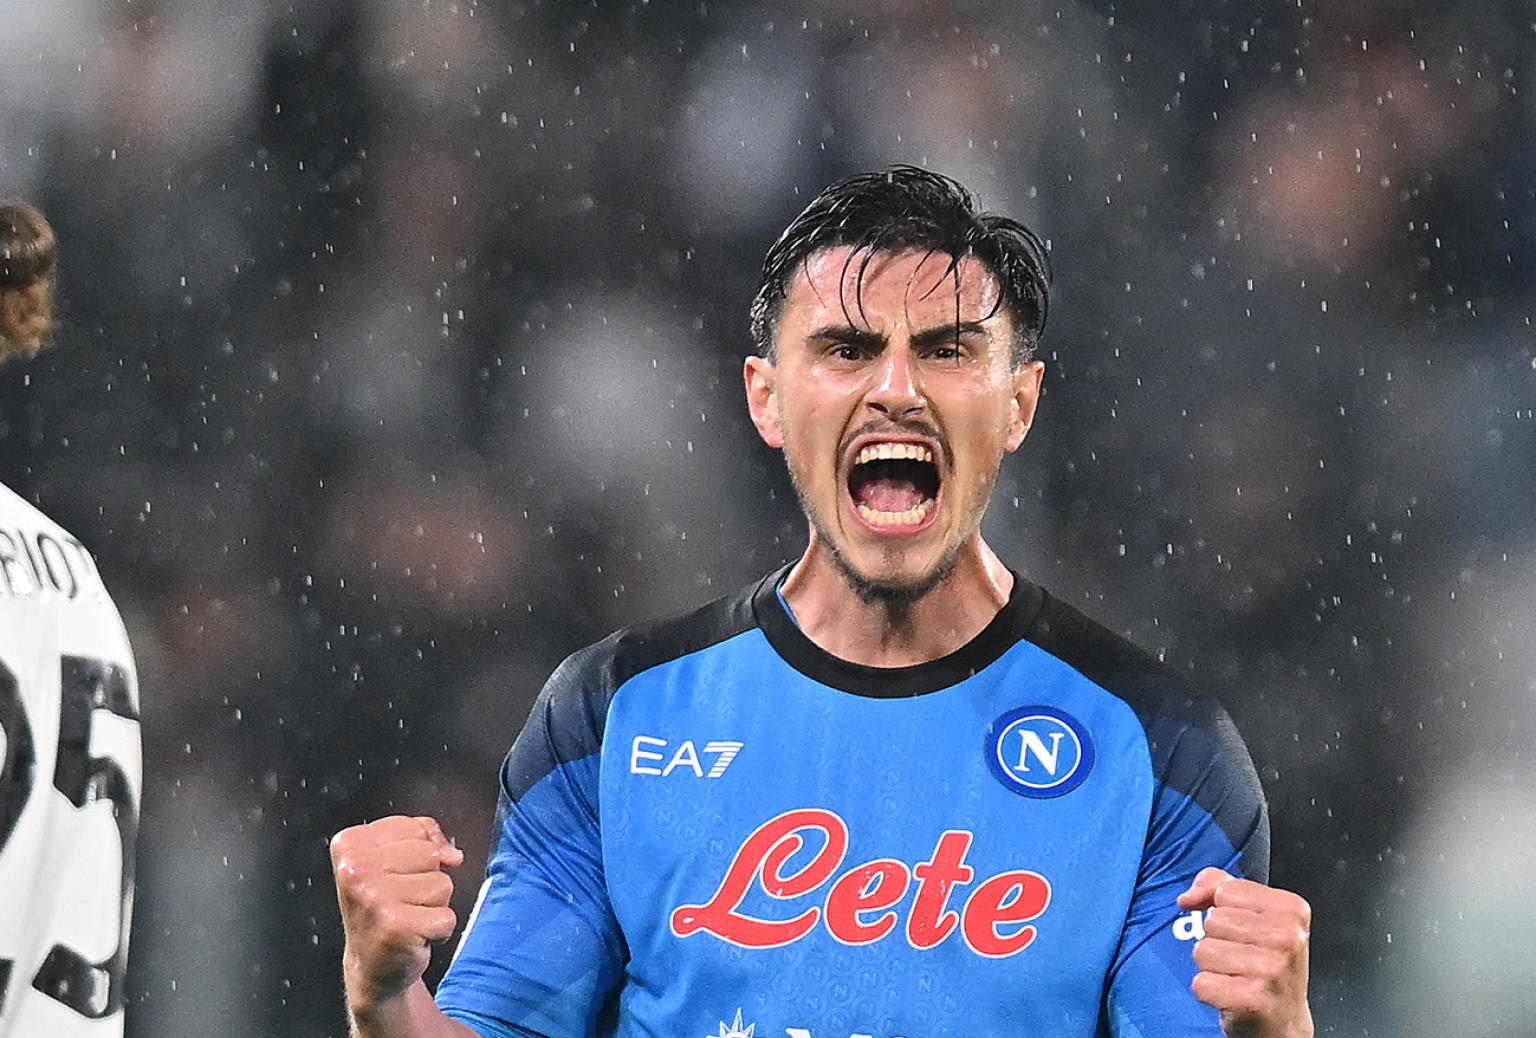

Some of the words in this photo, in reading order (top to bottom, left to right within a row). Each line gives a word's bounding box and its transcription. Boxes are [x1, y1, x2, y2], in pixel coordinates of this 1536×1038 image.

[630, 734, 745, 779] EA7
[1013, 729, 1064, 776] N
[669, 807, 1052, 959] Lete
